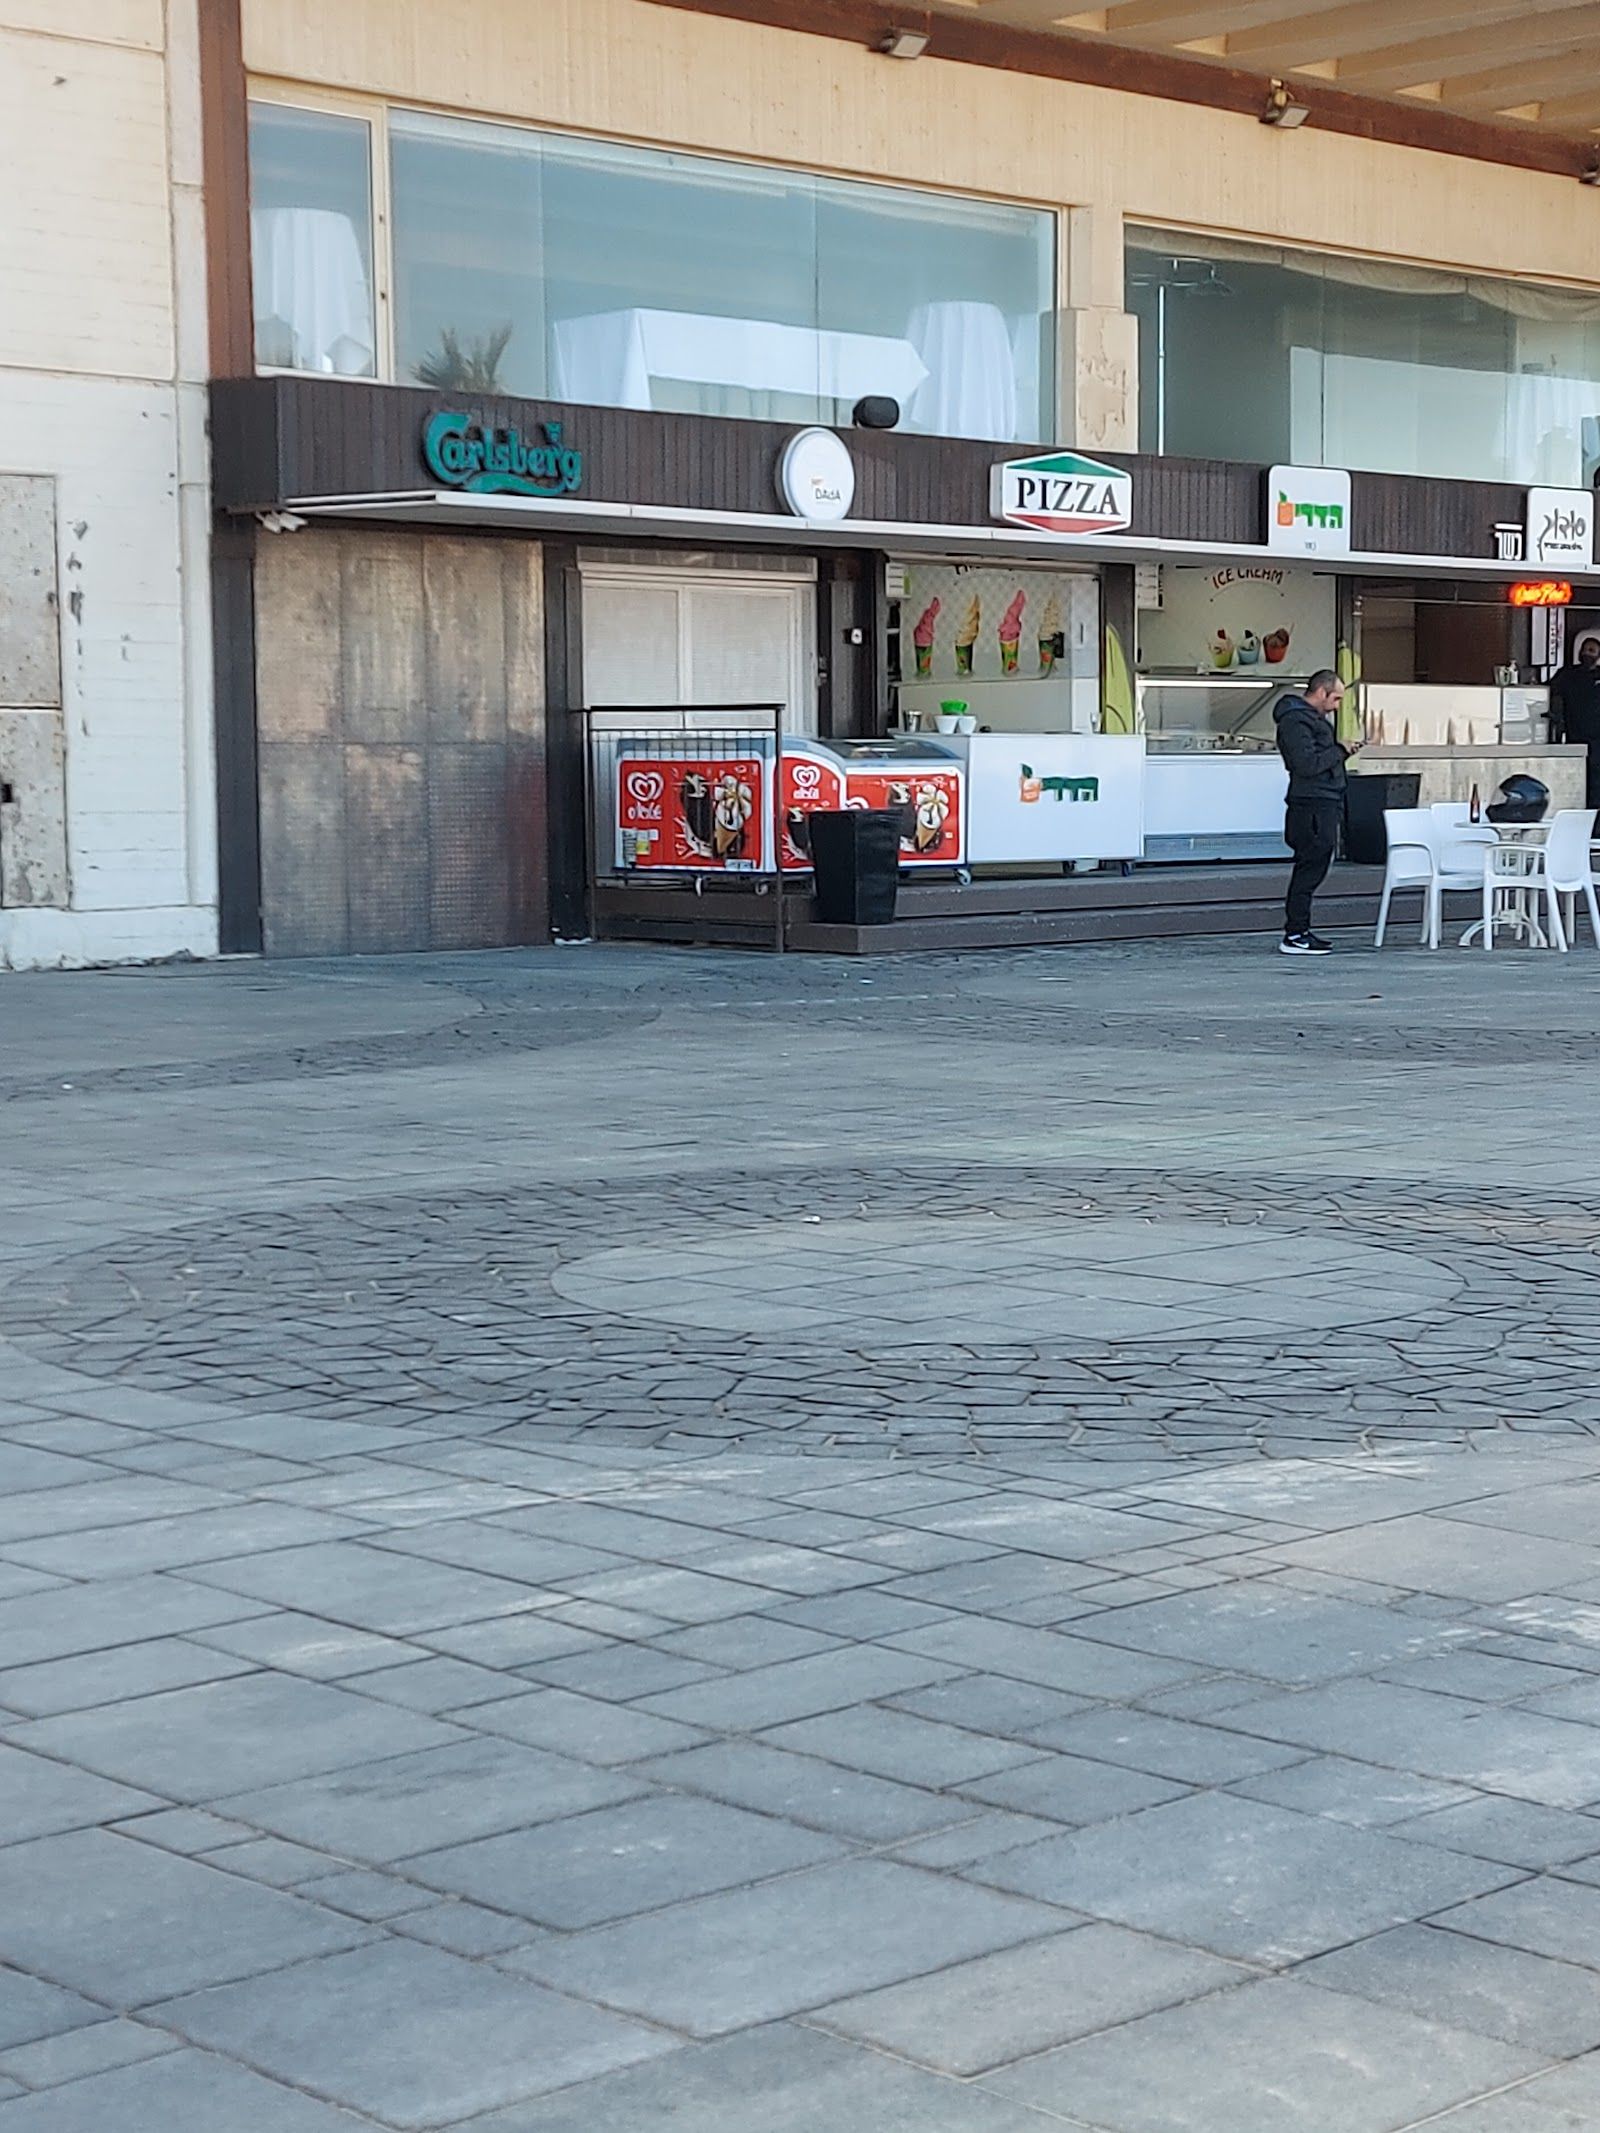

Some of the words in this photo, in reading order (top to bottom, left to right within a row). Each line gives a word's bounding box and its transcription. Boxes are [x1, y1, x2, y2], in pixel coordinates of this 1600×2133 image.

[426, 411, 582, 494] Carlsberg
[1015, 477, 1121, 516] PIZZA
[1212, 568, 1235, 589] ICE
